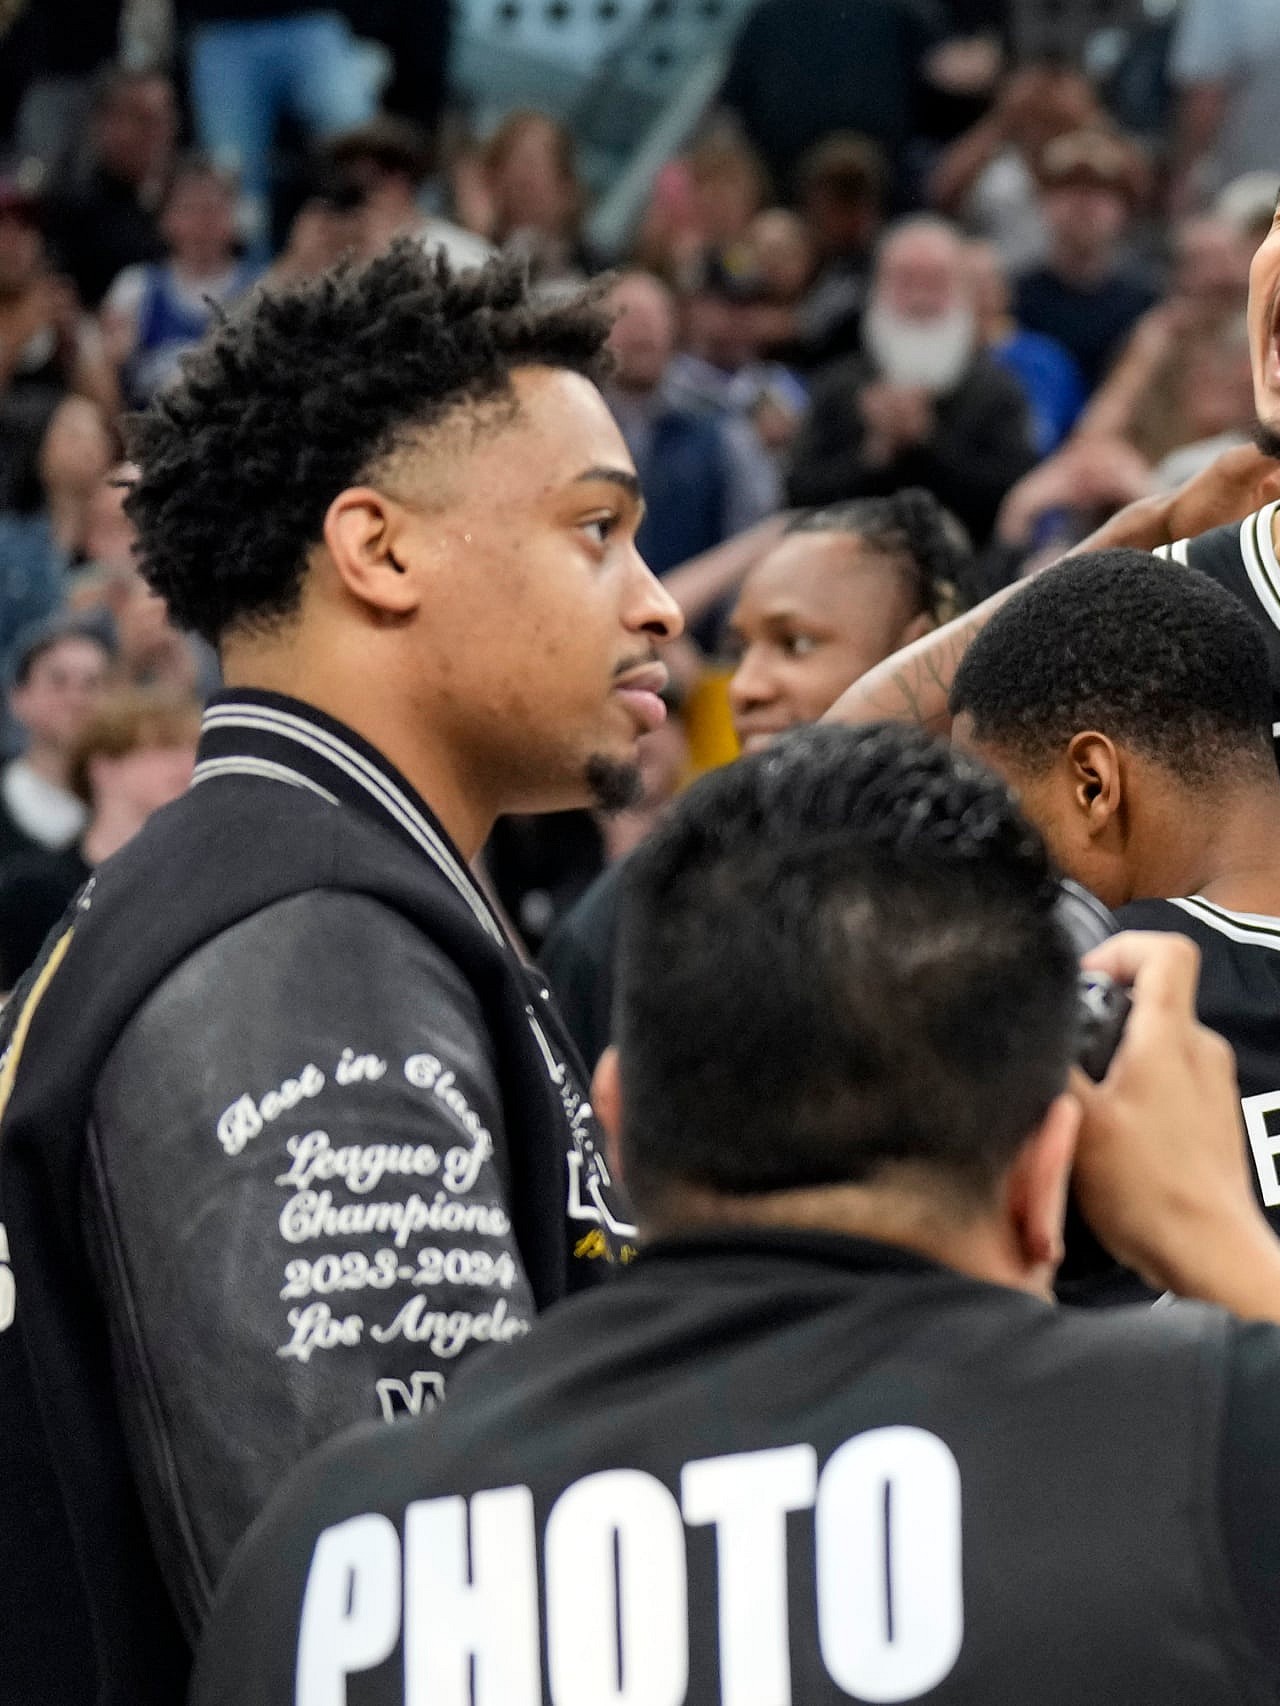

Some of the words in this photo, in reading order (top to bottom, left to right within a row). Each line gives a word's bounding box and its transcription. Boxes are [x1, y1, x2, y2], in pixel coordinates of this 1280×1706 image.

[216, 1063, 326, 1156] Best
[334, 1046, 388, 1086] in
[274, 1129, 441, 1195] League
[442, 1129, 493, 1195] of
[278, 1190, 511, 1249] Champions
[279, 1247, 517, 1301] 2023-2024
[275, 1301, 365, 1363] Los
[293, 1424, 965, 1706] PHOTO
